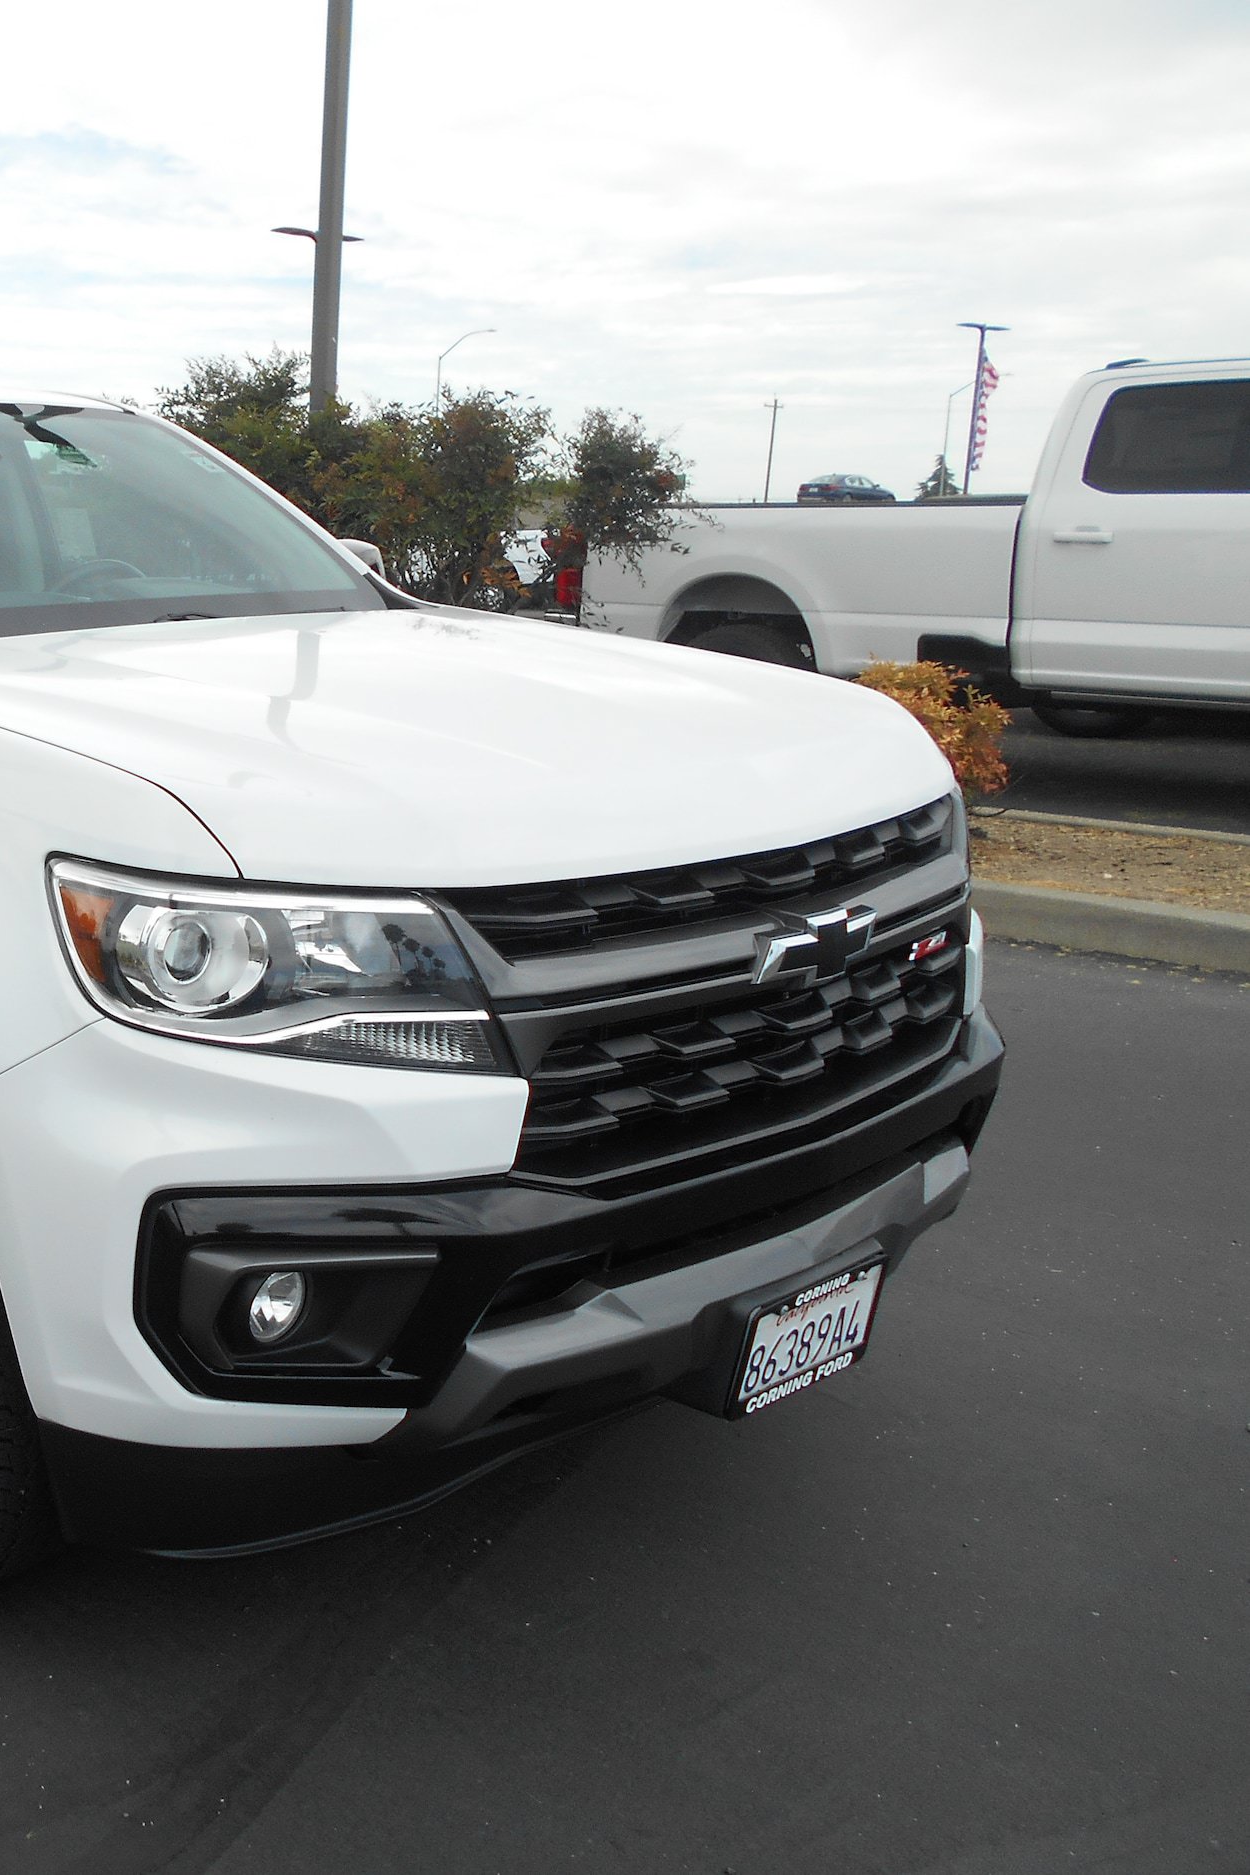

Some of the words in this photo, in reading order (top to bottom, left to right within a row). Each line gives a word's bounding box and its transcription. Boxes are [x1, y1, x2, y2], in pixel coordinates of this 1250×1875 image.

[794, 1272, 851, 1307] CORNING
[743, 1300, 860, 1393] 86389A4
[745, 1370, 814, 1414] CORNING
[815, 1351, 854, 1382] FORD
